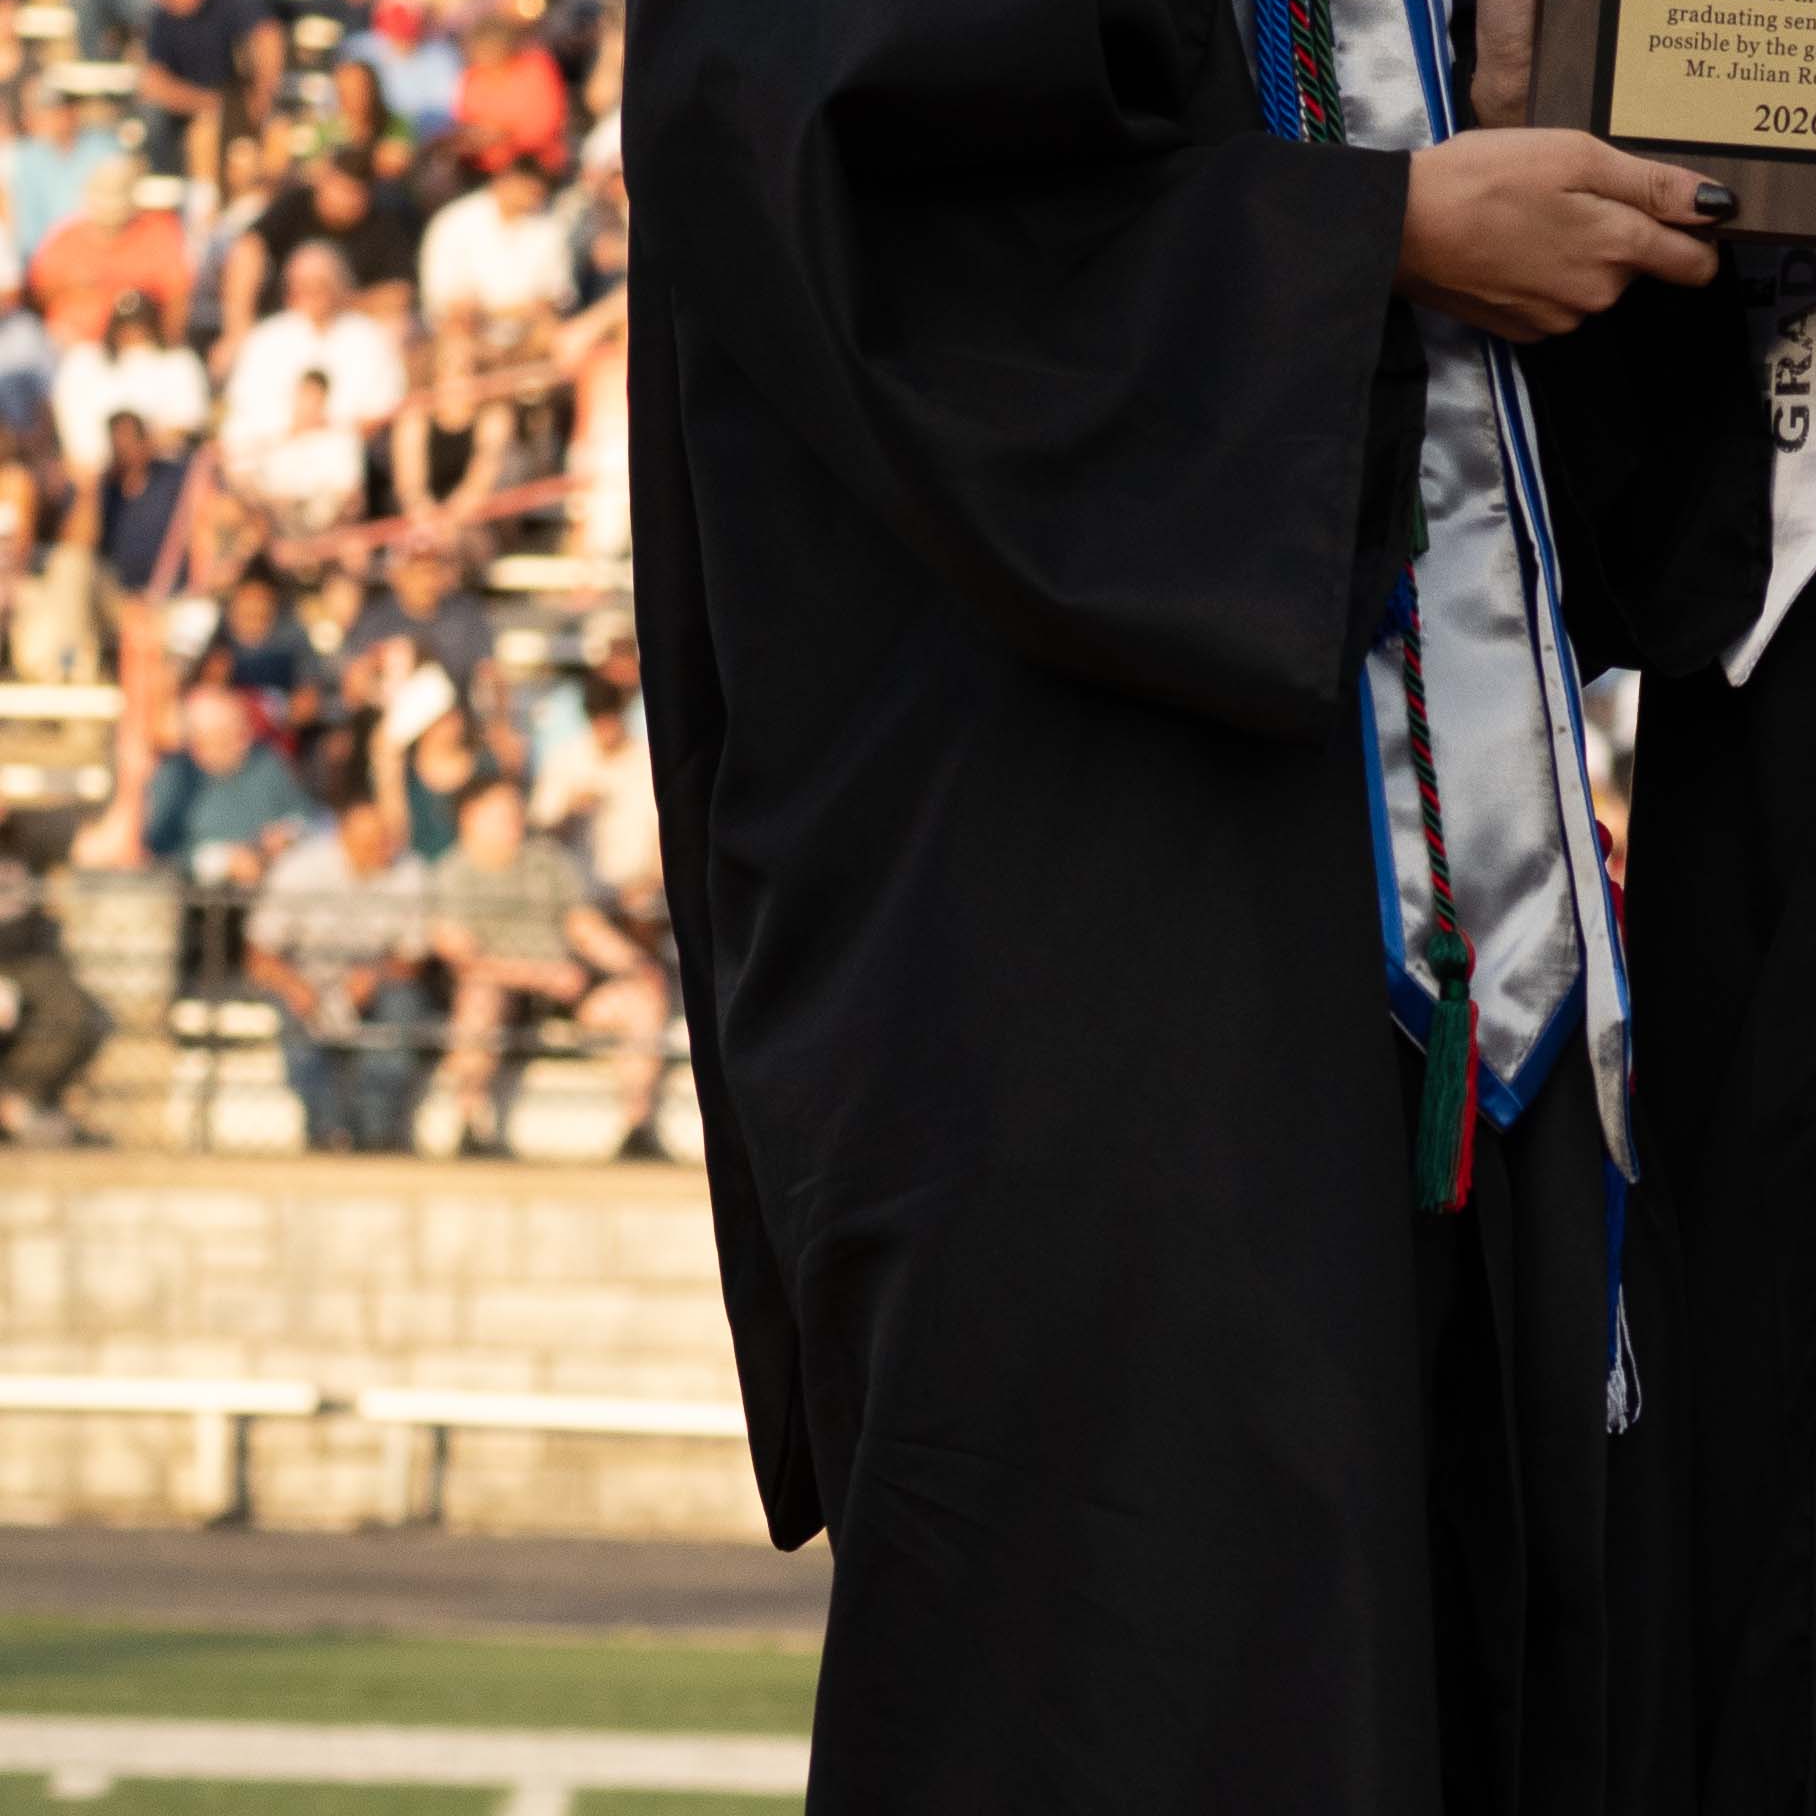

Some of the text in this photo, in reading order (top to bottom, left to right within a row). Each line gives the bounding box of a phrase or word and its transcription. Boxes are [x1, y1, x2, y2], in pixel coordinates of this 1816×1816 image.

[1667, 4, 1778, 31] graduating
[1649, 31, 1730, 53] possible
[1736, 34, 1761, 58] by
[1766, 37, 1798, 57] the
[1685, 59, 1721, 79] Mr.
[1727, 61, 1791, 83] Julian
